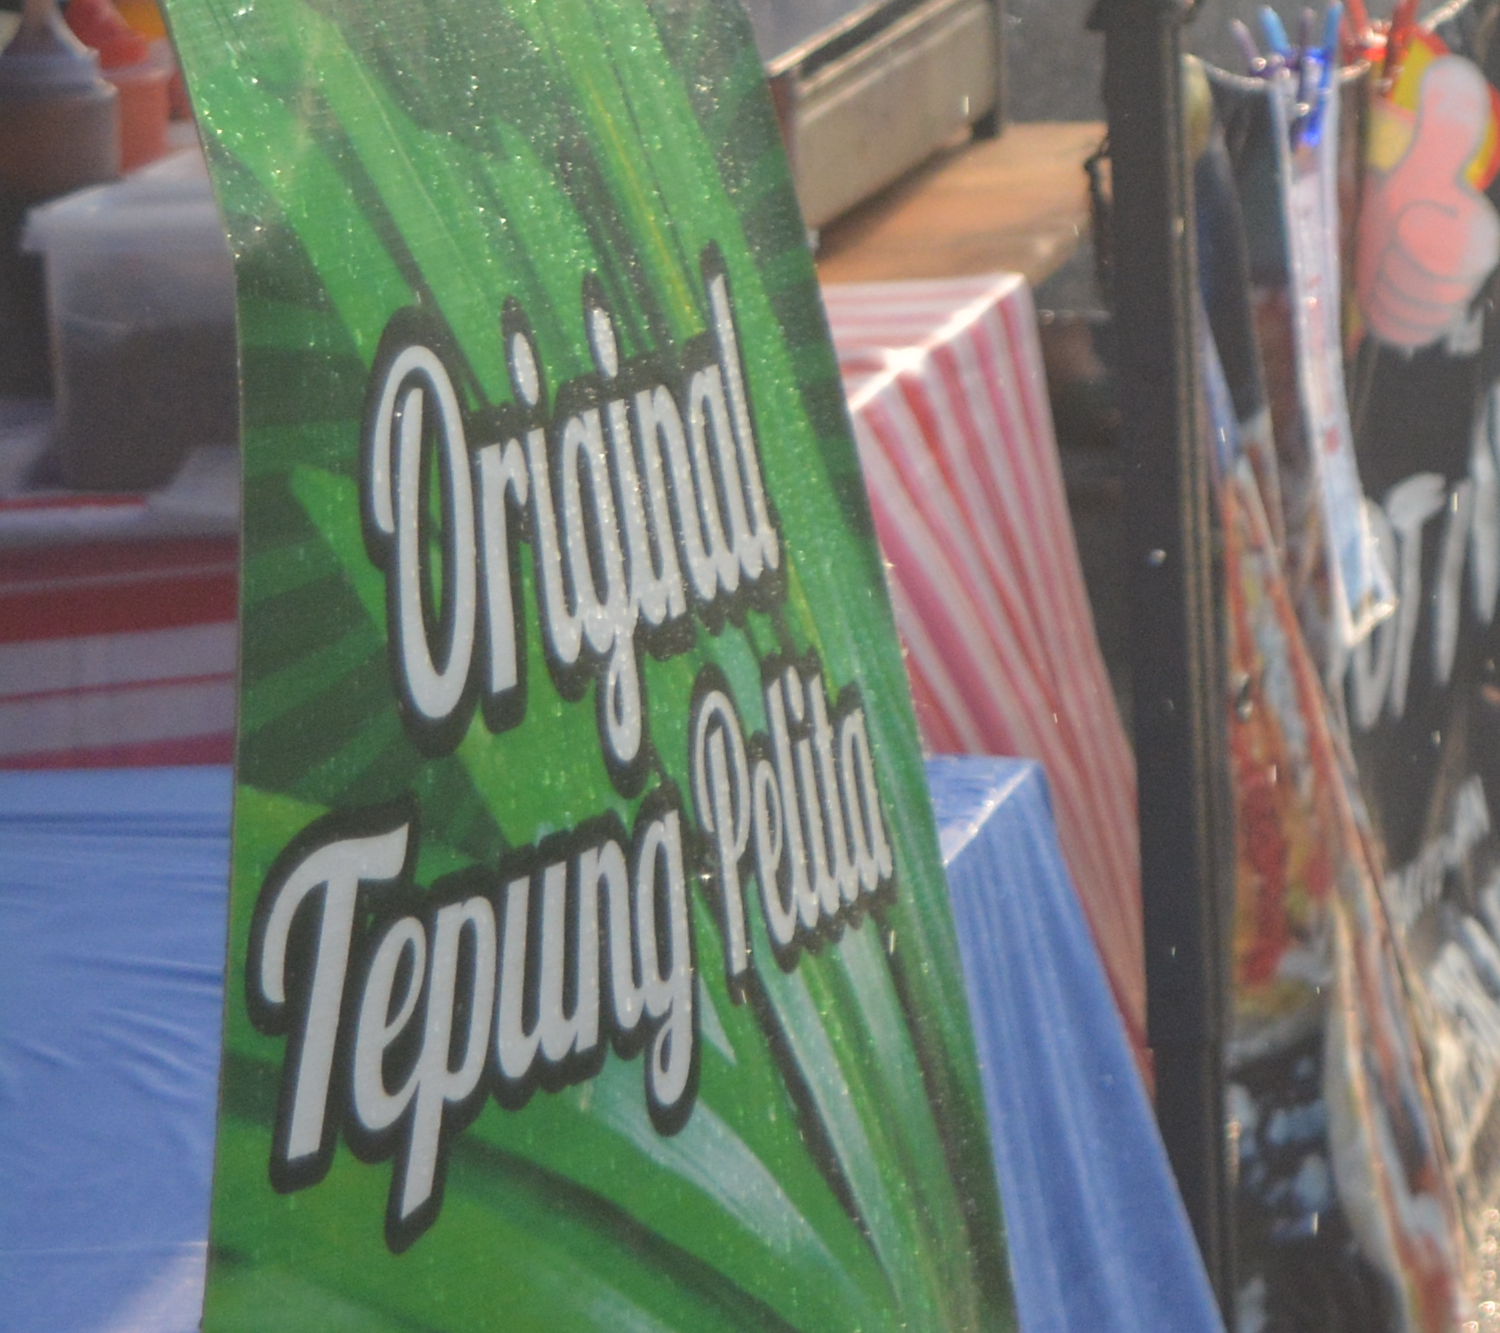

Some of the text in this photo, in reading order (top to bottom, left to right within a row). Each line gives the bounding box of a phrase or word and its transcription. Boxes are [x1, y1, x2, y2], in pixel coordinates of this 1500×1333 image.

[371, 272, 780, 763] Original
[259, 664, 895, 1222] Tepung Pelita
